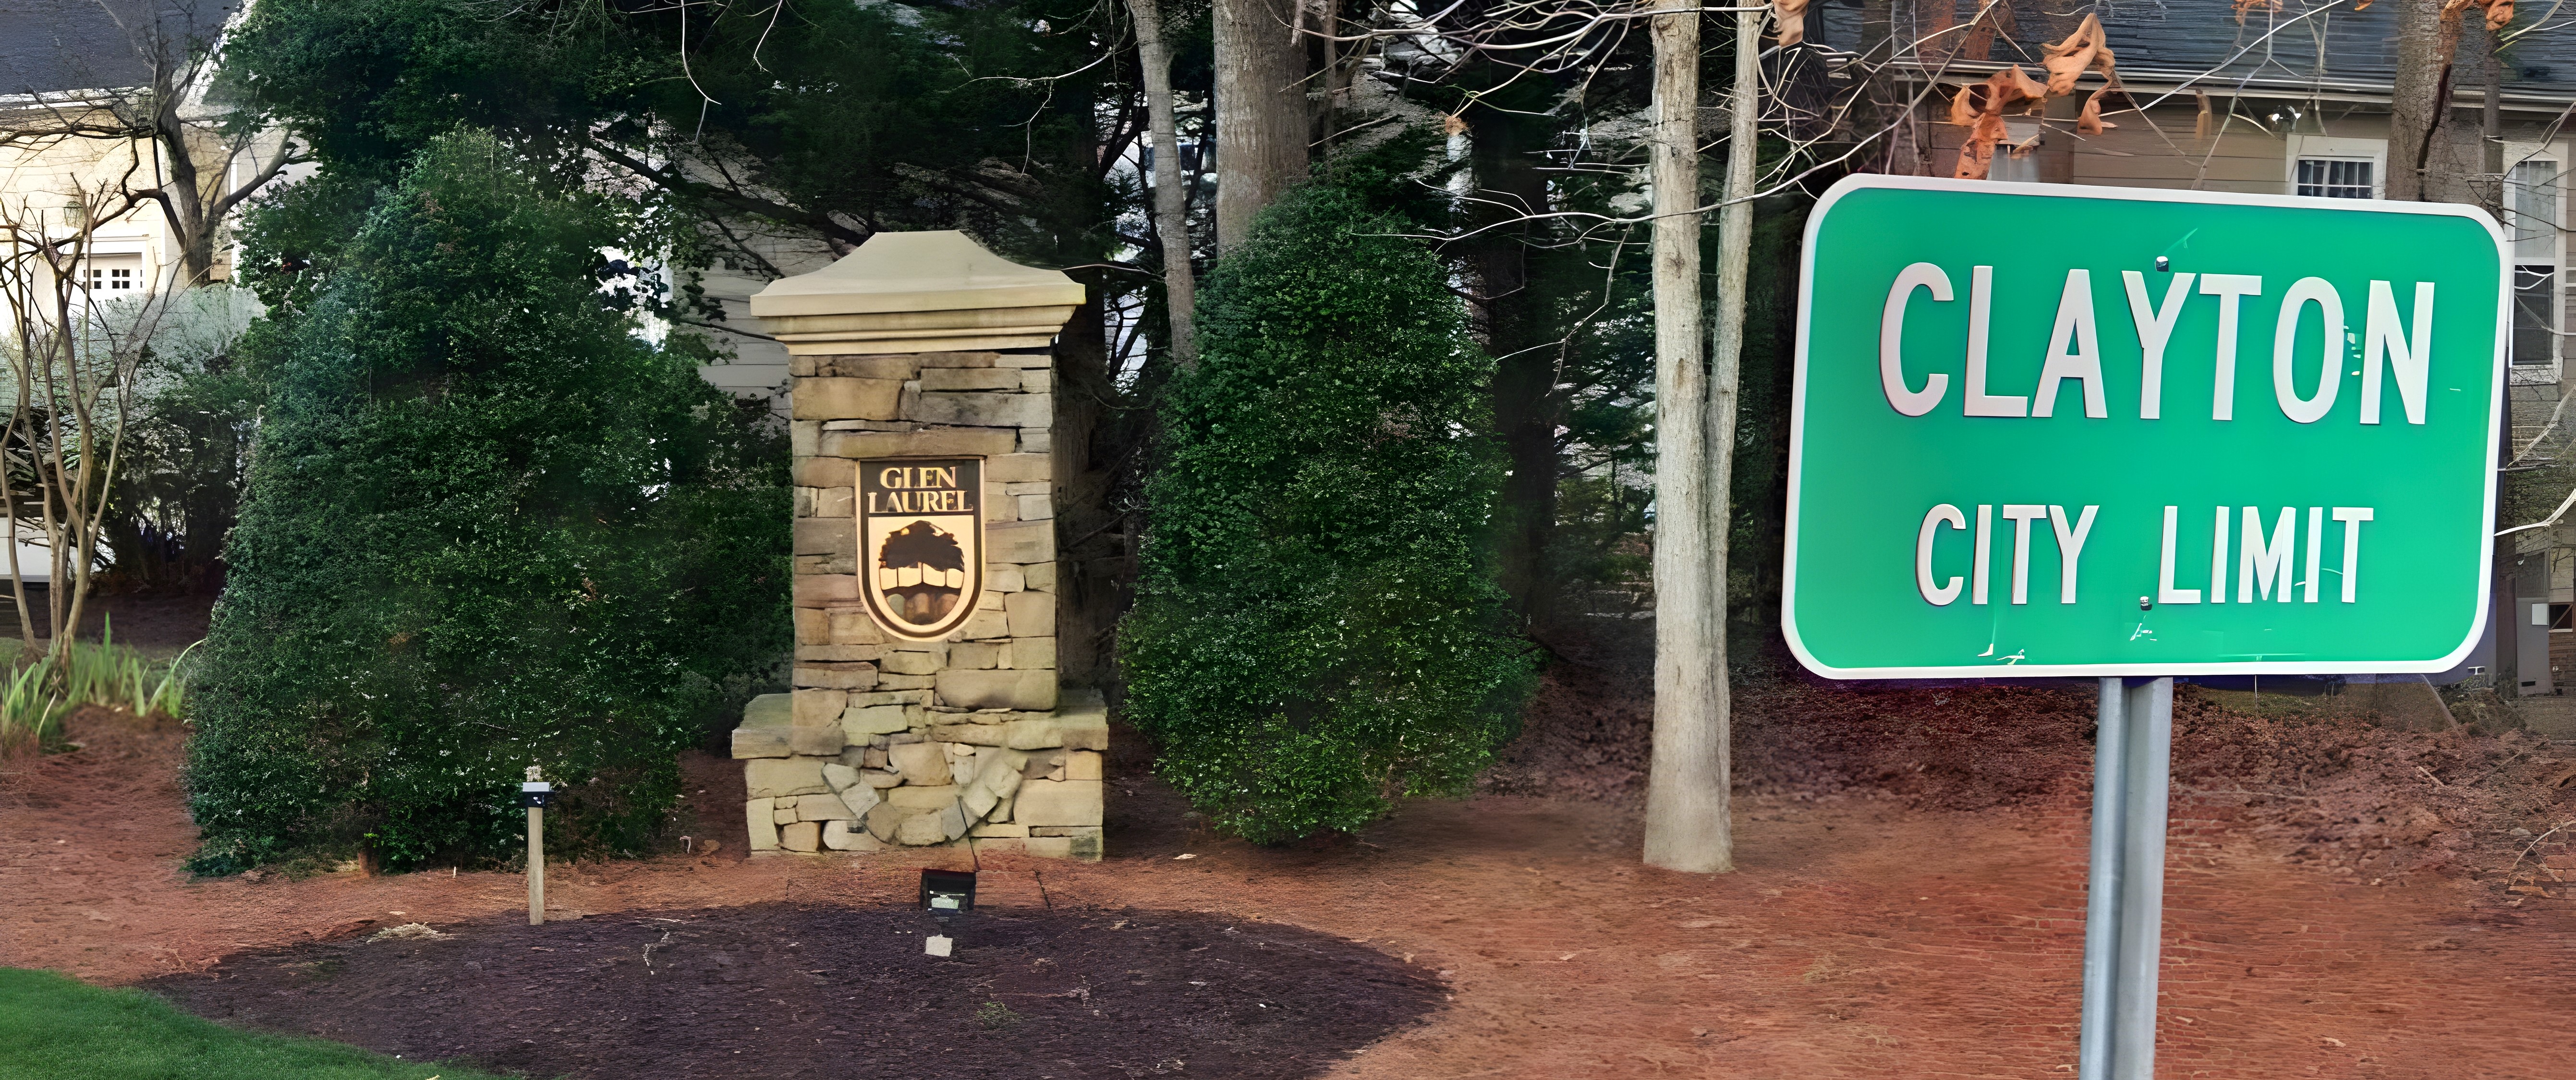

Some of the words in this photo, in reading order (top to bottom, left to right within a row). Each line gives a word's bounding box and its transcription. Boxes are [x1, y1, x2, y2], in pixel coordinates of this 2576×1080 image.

[1880, 262, 2434, 425] CLAYTON
[868, 490, 973, 512] LAUREL
[880, 467, 956, 488] GLEN
[1916, 504, 2100, 606] CITY
[2158, 506, 2374, 604] LIMIT
